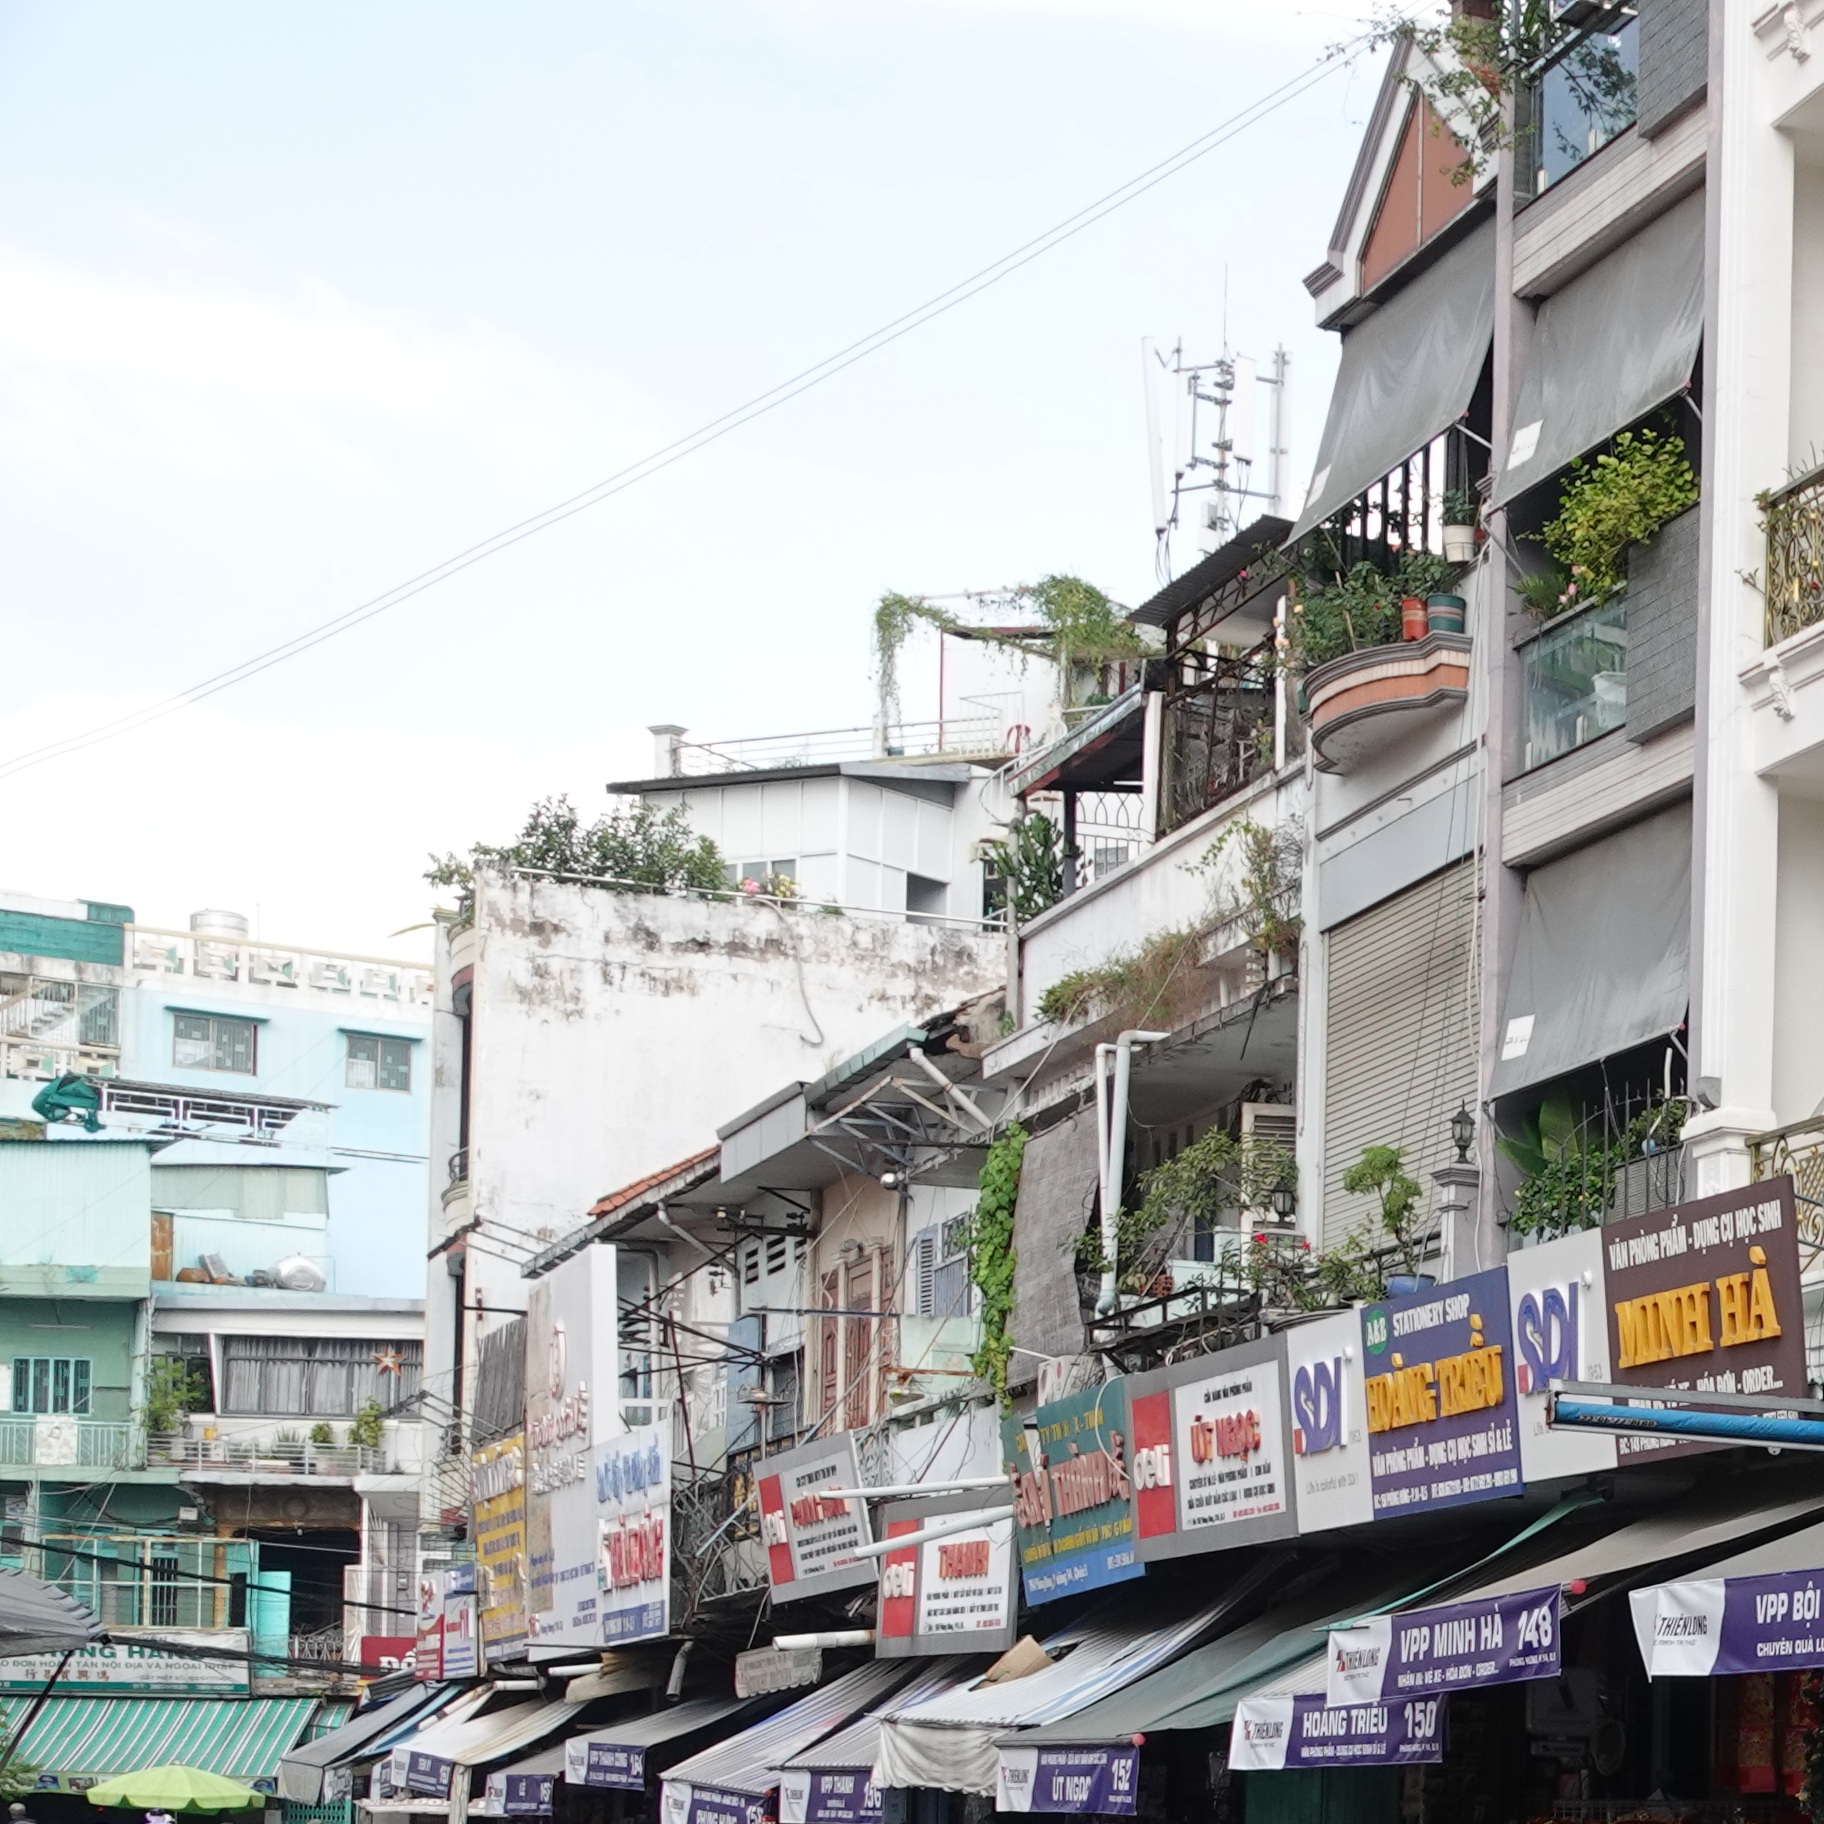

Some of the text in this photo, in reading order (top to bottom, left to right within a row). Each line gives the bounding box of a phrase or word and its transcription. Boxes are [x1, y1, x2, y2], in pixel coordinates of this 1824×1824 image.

[1609, 1199, 1782, 1271] VĂN PHÒNG PHẨM DỤNG CỤ HỌC SINH
[1393, 1293, 1470, 1337] STATIONERY SHOP
[1614, 1245, 1782, 1369] MINH HÀ
[1517, 1280, 1580, 1393] SDI
[1294, 1355, 1345, 1455] SDI
[1365, 1352, 1436, 1433] HOÀNG
[1517, 1604, 1553, 1650] 148
[1755, 1593, 1789, 1625] VPP
[1792, 1580, 1821, 1629] BỘI
[1400, 1602, 1504, 1664] VPP MINH HÀ
[1756, 1638, 1793, 1657] CHUYÊN
[1794, 1635, 1814, 1655] QUÀ
[1404, 1701, 1437, 1740] 150
[1052, 1768, 1092, 1808] ÚT NGỌC
[1111, 1758, 1133, 1791] 152
